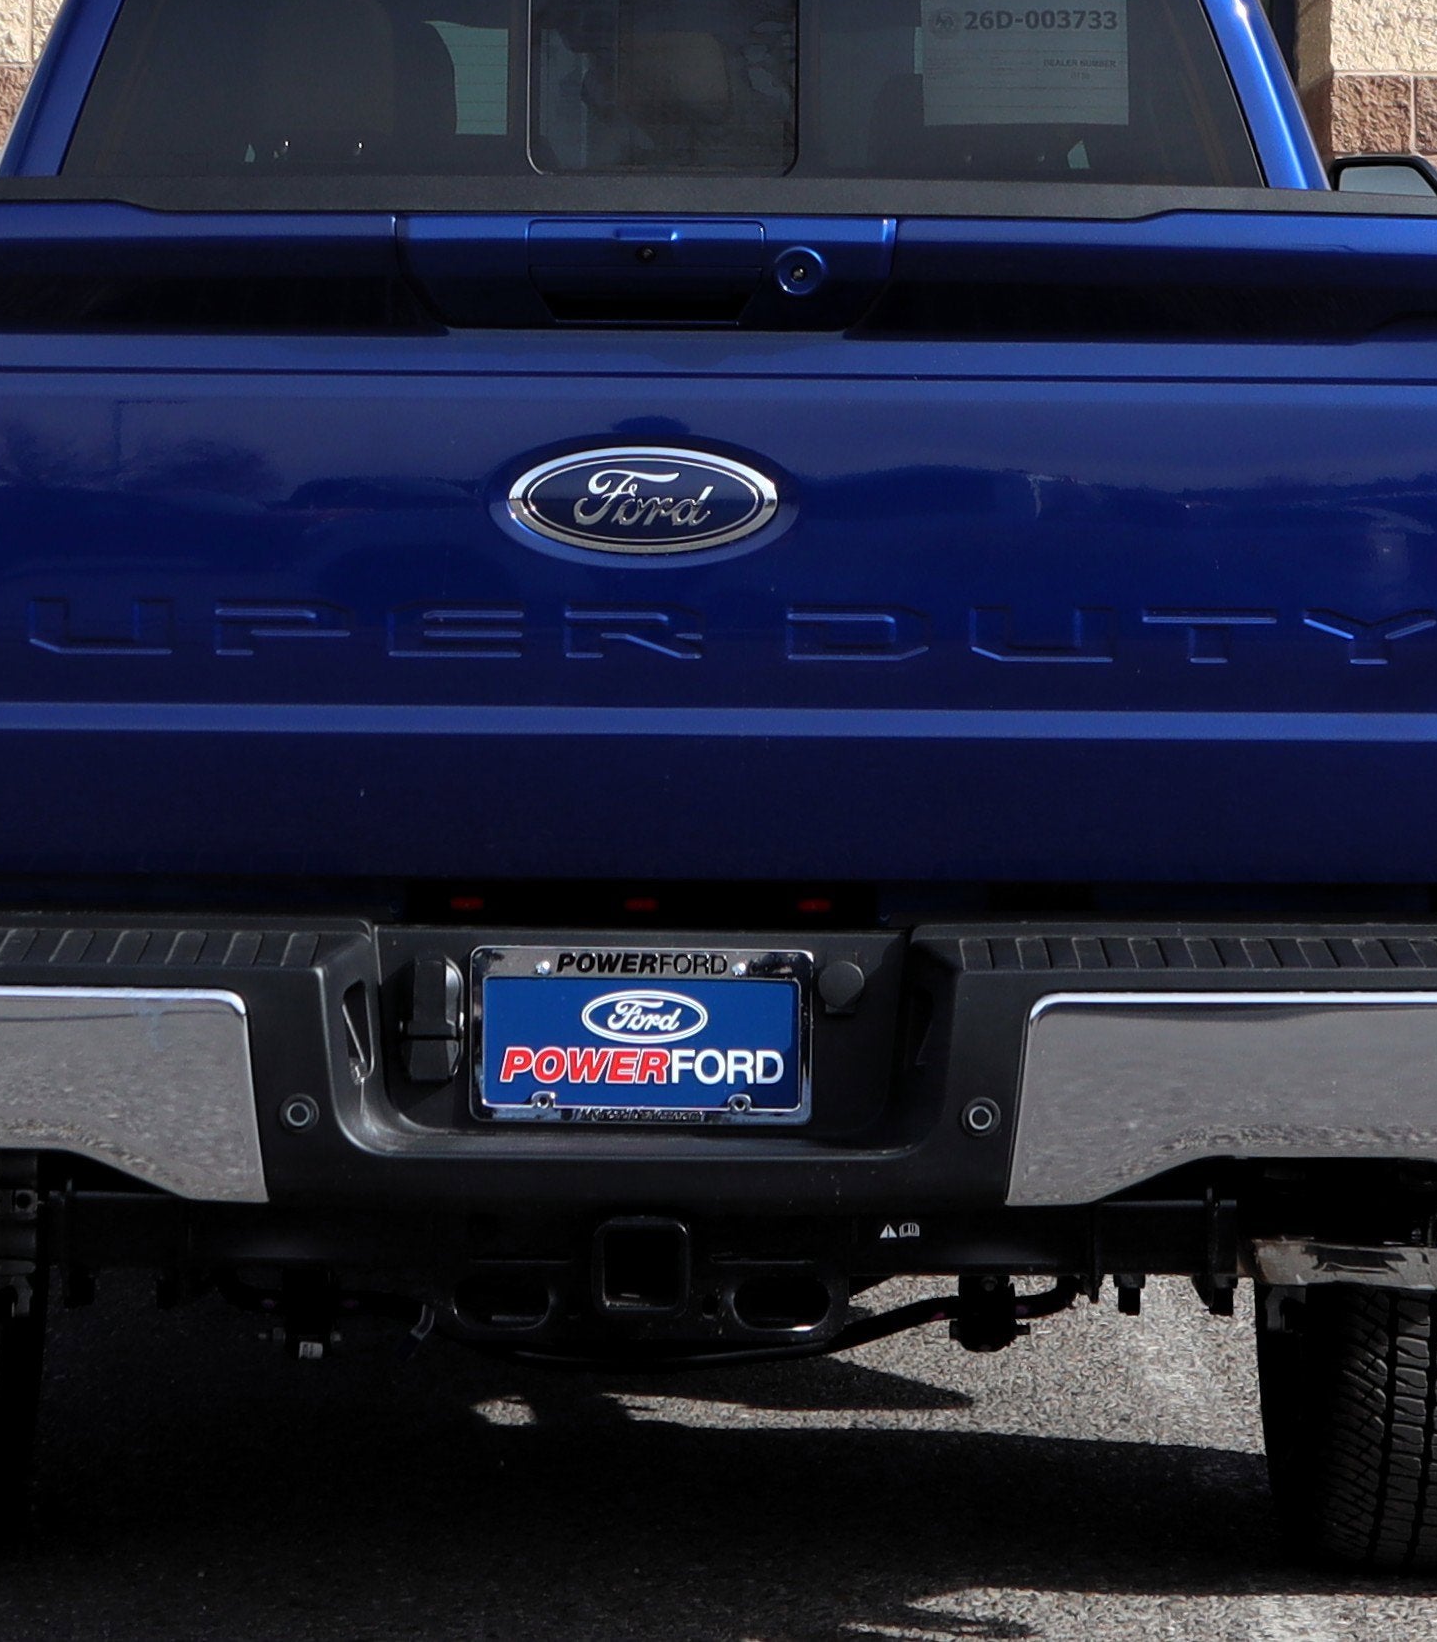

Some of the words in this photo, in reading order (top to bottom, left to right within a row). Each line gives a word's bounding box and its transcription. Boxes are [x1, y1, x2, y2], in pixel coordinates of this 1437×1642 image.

[964, 9, 1118, 31] 26D-003733
[573, 467, 713, 530] Ford
[606, 999, 681, 1031] Ford
